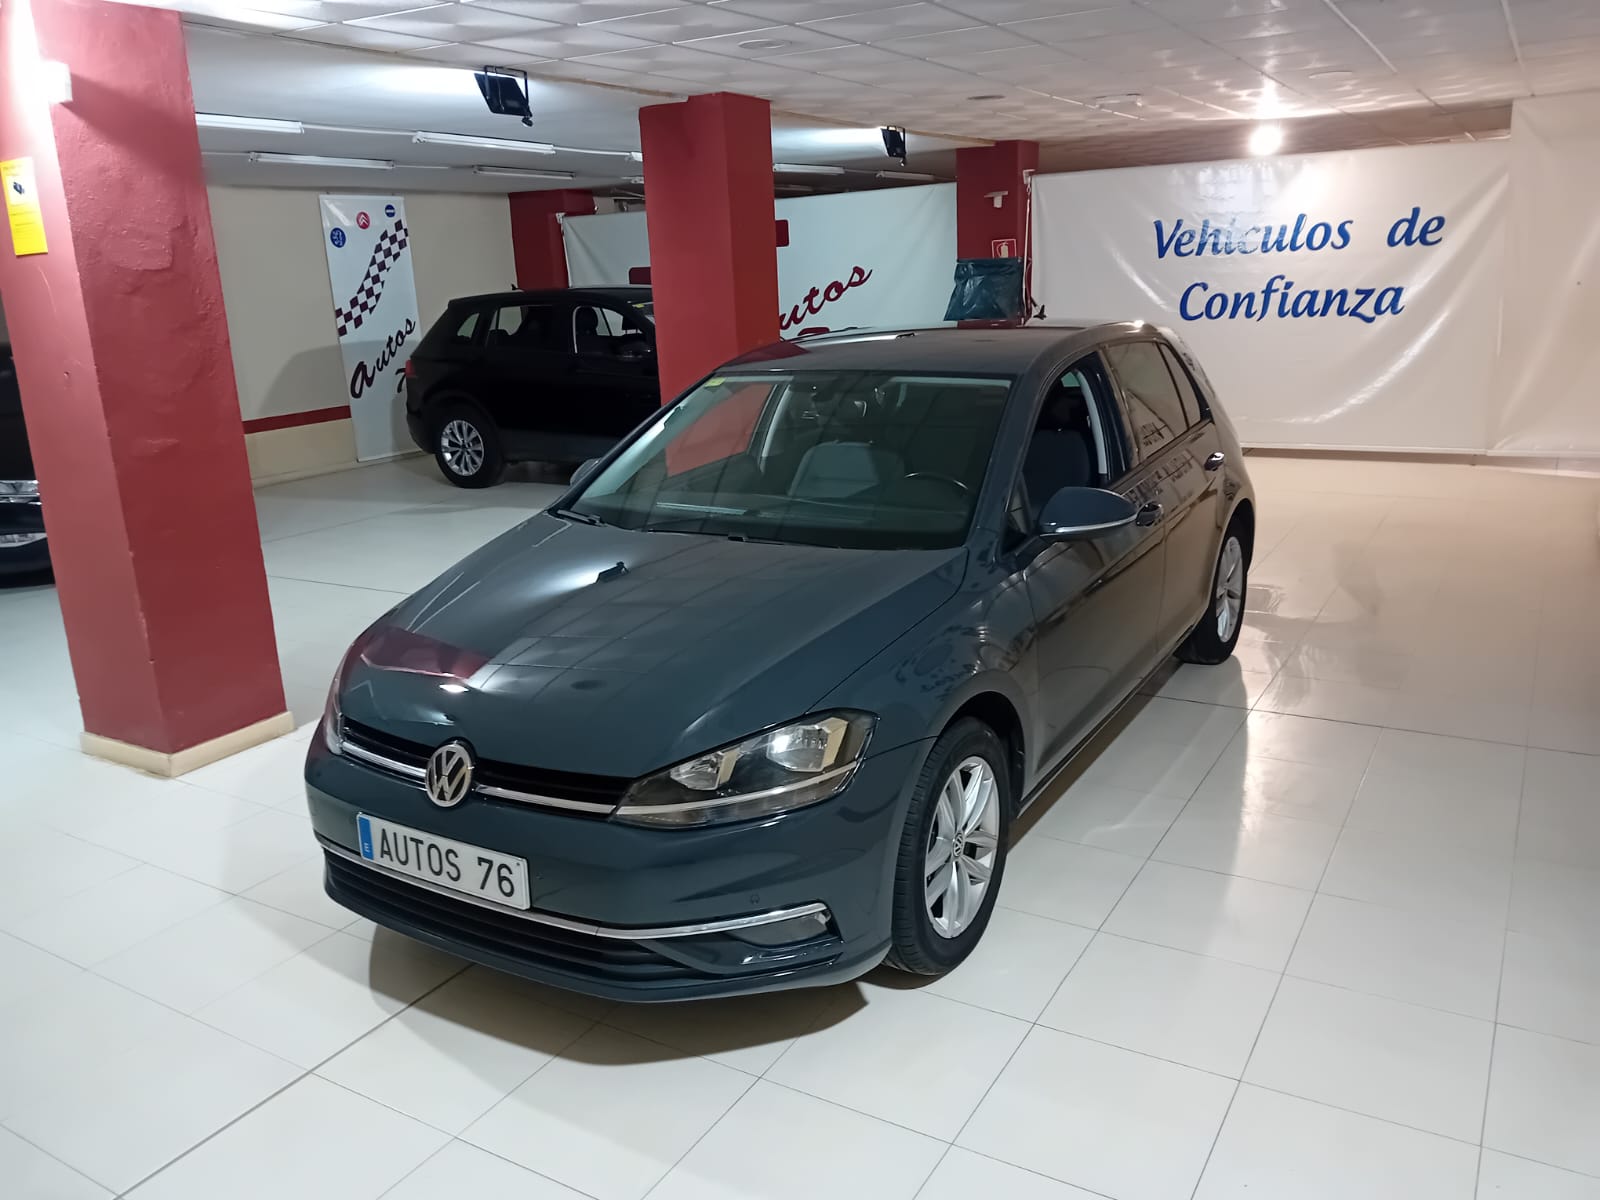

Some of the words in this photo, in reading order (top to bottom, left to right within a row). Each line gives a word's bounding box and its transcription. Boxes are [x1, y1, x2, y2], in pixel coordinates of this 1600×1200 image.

[1387, 207, 1446, 247] de
[779, 266, 873, 330] utos
[1179, 275, 1405, 323] Confianza
[395, 367, 407, 393] 7
[380, 828, 461, 882] AUTOS
[477, 857, 515, 897] 76
